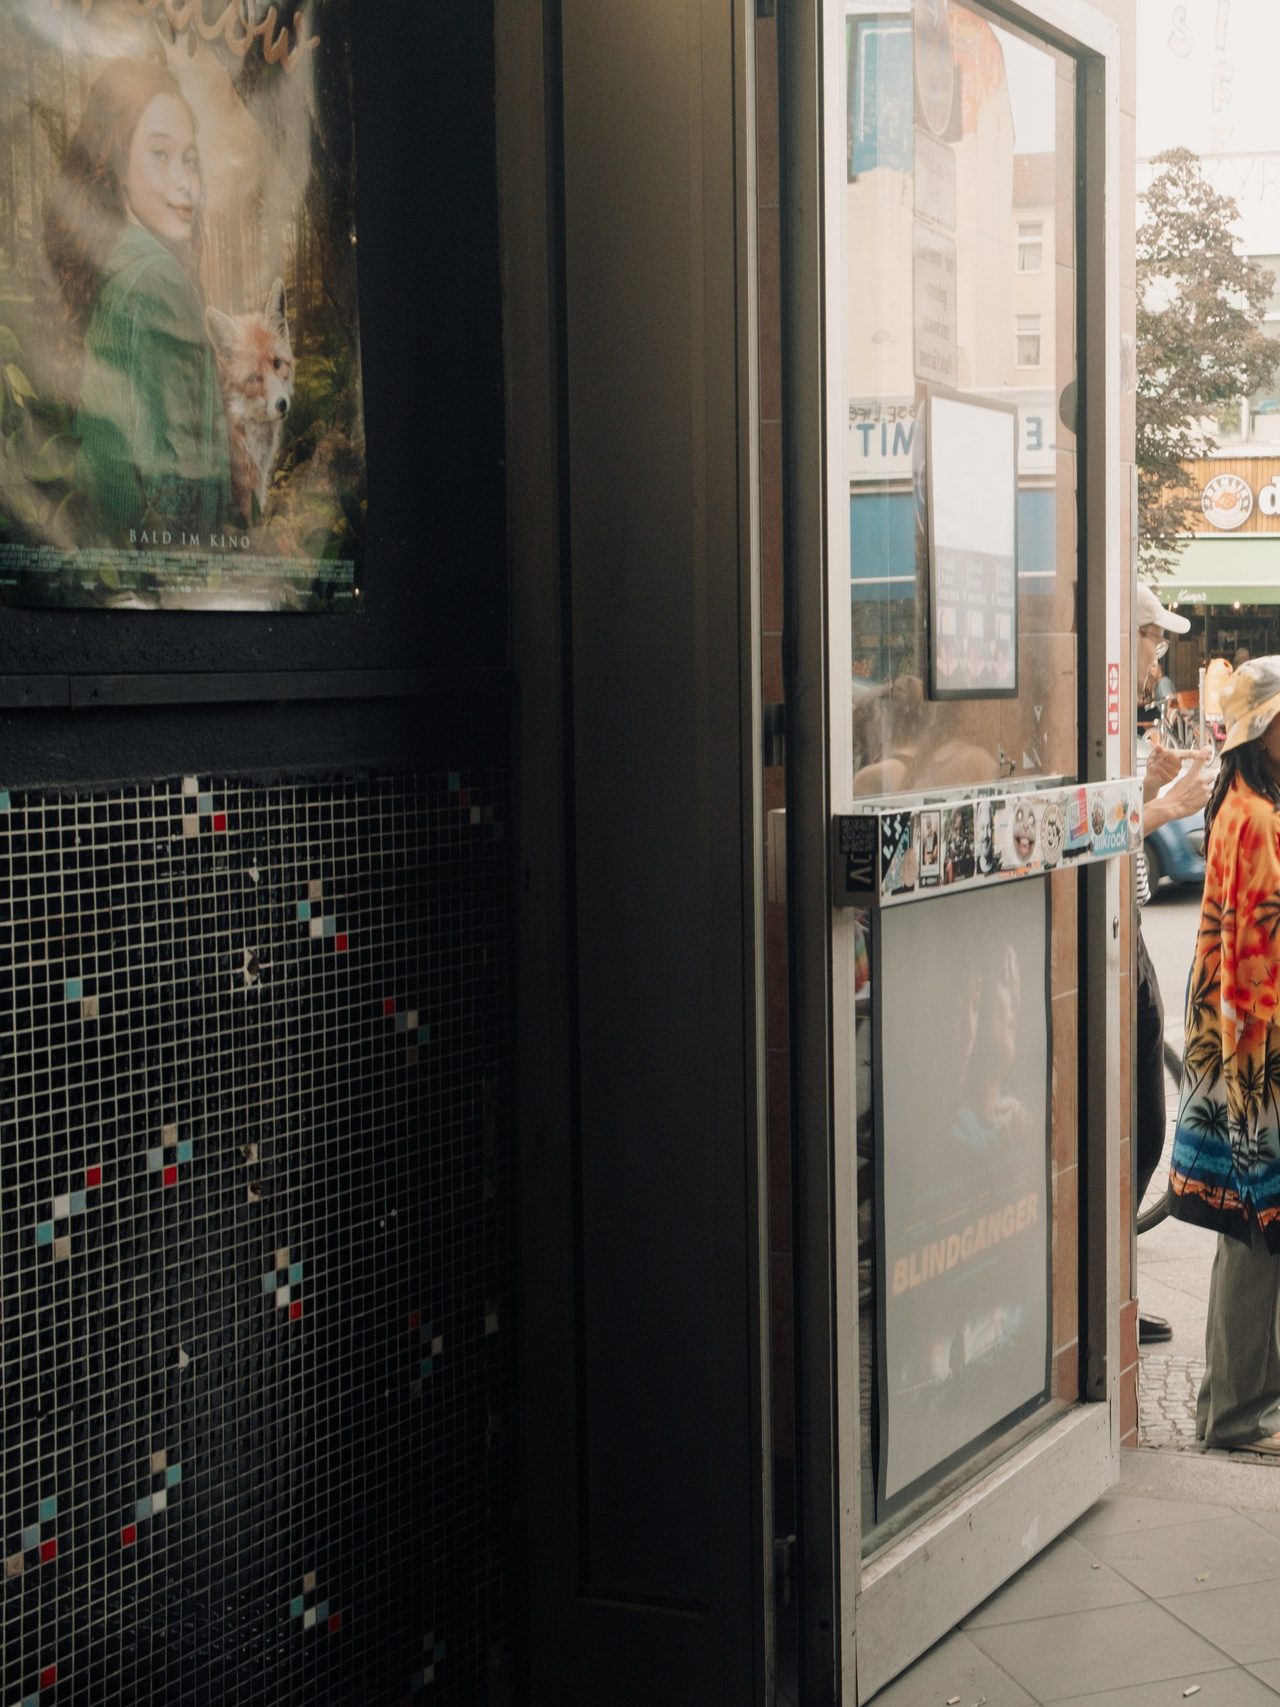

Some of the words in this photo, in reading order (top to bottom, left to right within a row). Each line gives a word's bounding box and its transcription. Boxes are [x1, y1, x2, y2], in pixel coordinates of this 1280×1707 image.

[128, 528, 173, 546] BALD
[181, 531, 201, 547] IM
[209, 533, 251, 549] KINO
